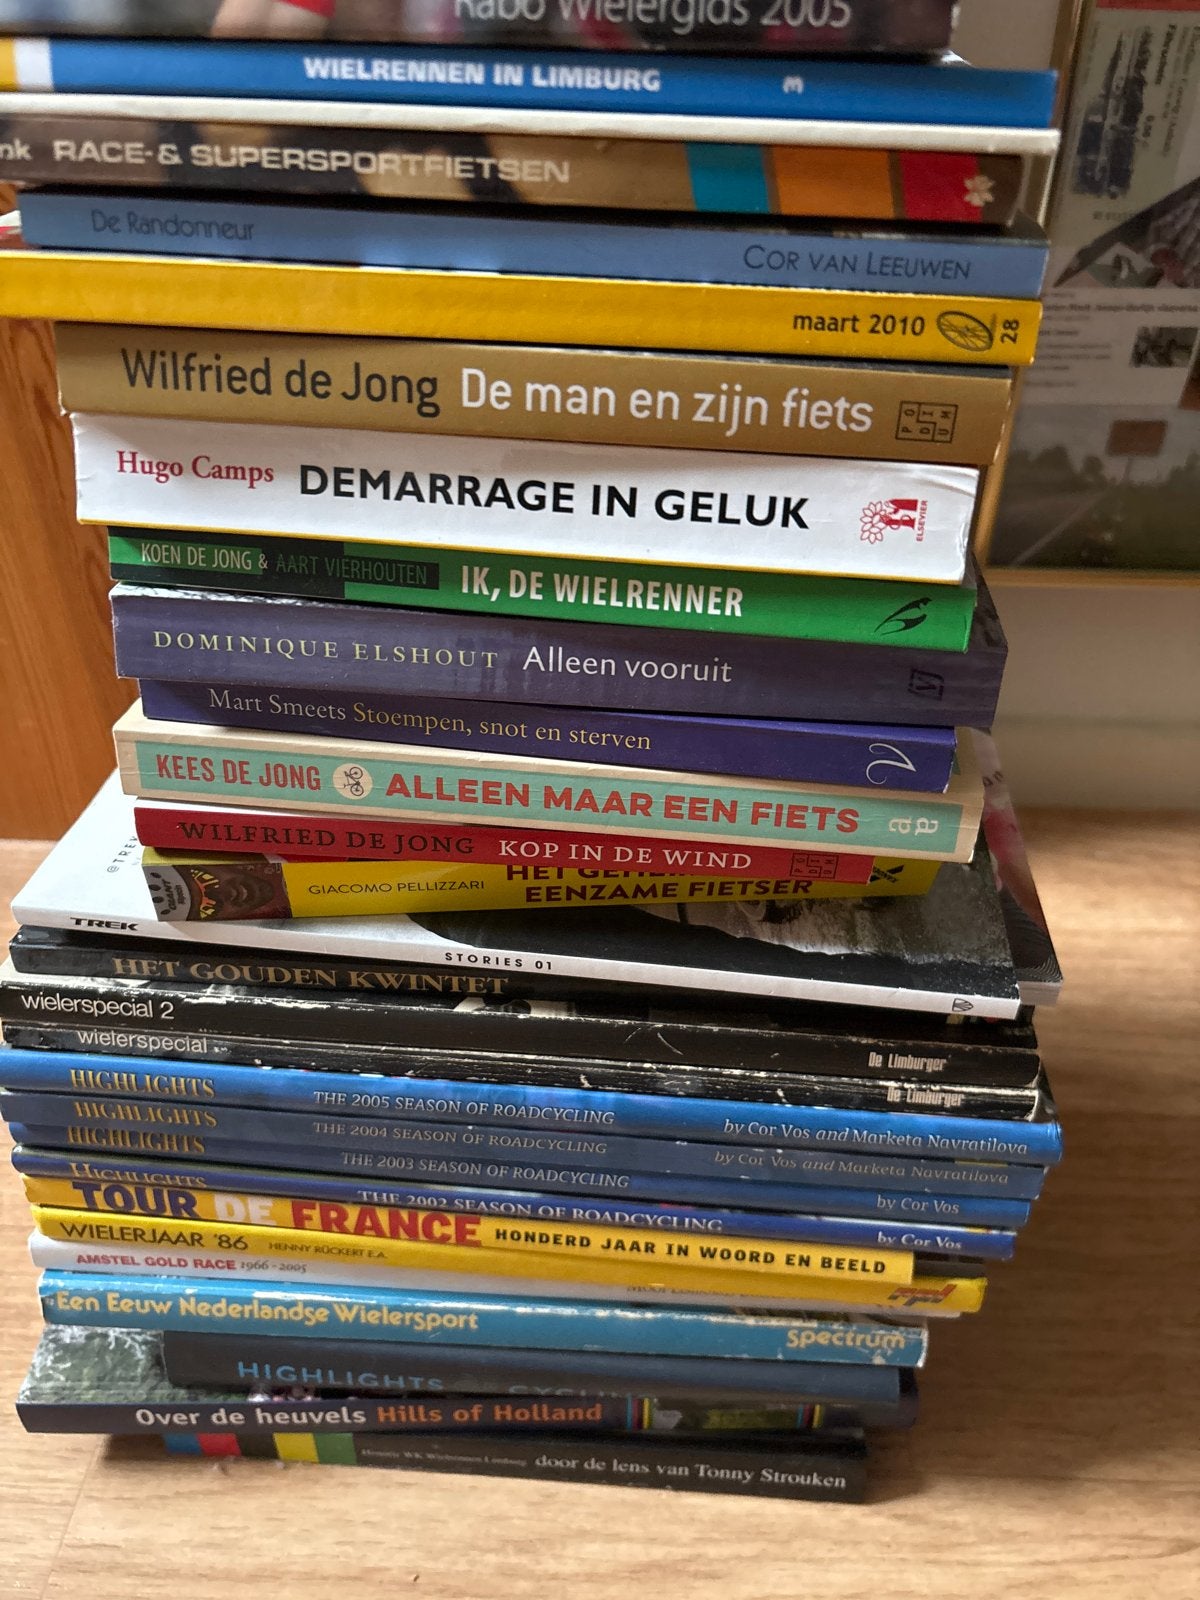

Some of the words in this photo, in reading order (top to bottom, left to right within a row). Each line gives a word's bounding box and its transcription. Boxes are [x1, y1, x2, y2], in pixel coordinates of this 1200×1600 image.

[304, 57, 484, 85] WIELRENNEN
[494, 62, 524, 86] IN
[532, 65, 661, 92] LIMBURG
[157, 143, 183, 165] &
[190, 144, 571, 184] SUPERSPORTFIETSEN
[91, 209, 121, 234] De
[128, 212, 254, 242] Randonneur
[865, 249, 971, 281] LEEUWEN
[792, 312, 859, 335] maart
[869, 313, 926, 337] 2010
[1000, 318, 1020, 345] 28
[120, 347, 272, 397] Wilfried
[284, 359, 332, 399] de
[341, 362, 440, 418] Jong
[461, 368, 511, 410] De
[525, 381, 616, 418] man
[630, 389, 679, 420] en
[692, 384, 768, 437] zijn
[782, 387, 873, 432] fiets
[117, 451, 184, 484] Hugo
[192, 455, 275, 489] Camps
[300, 464, 575, 513] DEMARRAGE
[593, 484, 637, 518] IN
[655, 488, 810, 531] GELUK
[915, 500, 929, 542] ELSEVIER
[141, 542, 182, 566] KOEN
[188, 546, 207, 568] DE
[212, 547, 252, 573] JONG
[258, 552, 269, 571] &
[275, 552, 318, 576] AART
[325, 557, 428, 586] VIERHOUTEN
[461, 565, 501, 604] IK,
[509, 569, 543, 601] DE
[553, 572, 744, 618] WIELRENNER
[153, 630, 339, 660] DOMINIQUE
[354, 642, 499, 670] ELSHOUT
[522, 645, 617, 678] Alleen
[625, 655, 733, 683] vooruit
[208, 688, 263, 715] Mart
[268, 693, 347, 722] Smeets
[353, 701, 472, 738] Stoempen,
[479, 717, 528, 740] snot
[536, 722, 562, 742] en
[569, 727, 652, 751] sterven
[156, 753, 215, 783] KEES
[223, 758, 252, 786] DE
[259, 762, 322, 791] JONG
[385, 773, 531, 808] ALLEEN
[543, 786, 653, 818] MAAR
[663, 795, 739, 824] EEN
[750, 802, 861, 834] FIETS
[177, 821, 337, 849] WILFRIED
[346, 831, 386, 851] DE
[393, 834, 476, 856] JONG
[498, 839, 559, 860] KOP
[568, 843, 604, 863] IN
[613, 846, 653, 865] DE
[662, 848, 753, 870] WIND
[308, 880, 394, 896] GIACOMO
[397, 878, 487, 894] PELLIZZARI
[525, 882, 678, 903] EENZAME
[689, 880, 813, 898] FIETSER
[70, 916, 139, 932] TREK
[112, 956, 180, 981] HET
[190, 962, 337, 989] GOUDEN
[349, 967, 510, 996] KWINTET
[445, 951, 524, 969] STORIES
[535, 959, 553, 972] 01
[21, 991, 153, 1018] wielerspecial
[160, 1001, 175, 1021] 2
[77, 1029, 208, 1054] wielerspecial
[868, 1051, 882, 1068] De
[888, 1053, 948, 1073] Limburger
[70, 1068, 217, 1099] HIGHLIGHTS
[73, 1100, 218, 1129] HIGHLIGHTS
[313, 1090, 348, 1107] THE
[351, 1091, 391, 1110] 2005
[395, 1096, 462, 1118] SEASON
[466, 1101, 490, 1118] OF
[493, 1101, 616, 1126] ROADCYCLING
[67, 1125, 206, 1154] HIGHLIGHTS
[313, 1120, 346, 1136] THE
[349, 1122, 388, 1139] 2004
[392, 1126, 458, 1144] SEASON
[462, 1131, 484, 1146] OF
[488, 1134, 609, 1155] ROADCYCLING
[724, 1118, 746, 1138] by
[747, 1120, 779, 1138] Cor
[782, 1123, 811, 1141] Vos
[816, 1126, 850, 1143] and
[852, 1132, 924, 1149] Marketa
[927, 1133, 1029, 1156] Navratilova
[341, 1150, 374, 1167] THE
[377, 1154, 415, 1171] 2003
[418, 1158, 482, 1176] SEASON
[486, 1164, 509, 1178] OF
[512, 1165, 631, 1189] ROADCYCLING
[714, 1149, 734, 1167] by
[738, 1152, 766, 1168] Cor
[771, 1153, 798, 1169] Vos
[802, 1155, 834, 1172] and
[838, 1160, 906, 1177] Marketa
[911, 1164, 1009, 1186] Navratilova
[72, 1181, 201, 1220] TOUR
[214, 1193, 276, 1226] DE
[292, 1199, 482, 1248] FRANCE
[405, 1194, 449, 1209] 2002
[454, 1198, 532, 1218] SEASON
[538, 1204, 566, 1219] OF
[572, 1208, 724, 1232] ROADCYCLING
[877, 1192, 897, 1211] by
[899, 1196, 927, 1214] Cor
[931, 1198, 961, 1215] Vos
[60, 1221, 203, 1248] WIELERJAAR
[212, 1231, 249, 1252] '86
[268, 1241, 312, 1255] HENNY
[314, 1243, 364, 1259] RÜCKERT
[495, 1229, 591, 1249] HONDERD
[601, 1237, 656, 1256] JAAR
[666, 1242, 690, 1258] IN
[699, 1246, 775, 1265] WOORD
[785, 1253, 811, 1268] EN
[821, 1256, 886, 1276] BEELD
[877, 1230, 898, 1247] by
[901, 1232, 932, 1249] Cor
[936, 1235, 963, 1252] Vos
[76, 1254, 141, 1268] AMSTEL
[145, 1255, 190, 1269] GOLD
[193, 1257, 237, 1271] RACE
[57, 1291, 99, 1313] Een
[107, 1291, 173, 1315] Eeuw
[179, 1295, 330, 1327] Nederlandse
[335, 1304, 479, 1331] Wielersport
[237, 1361, 443, 1391] HIGHLIGHTS
[136, 1408, 200, 1427] Over
[212, 1407, 246, 1427] de
[257, 1405, 367, 1425] heuvels
[377, 1402, 443, 1424] Hills
[454, 1401, 483, 1423] of
[494, 1402, 603, 1423] Holland
[535, 1454, 579, 1470] door
[584, 1457, 606, 1472] de
[612, 1458, 649, 1476] lens
[655, 1464, 690, 1477] van
[694, 1463, 755, 1484] Tonny
[759, 1467, 848, 1490] Strouken
